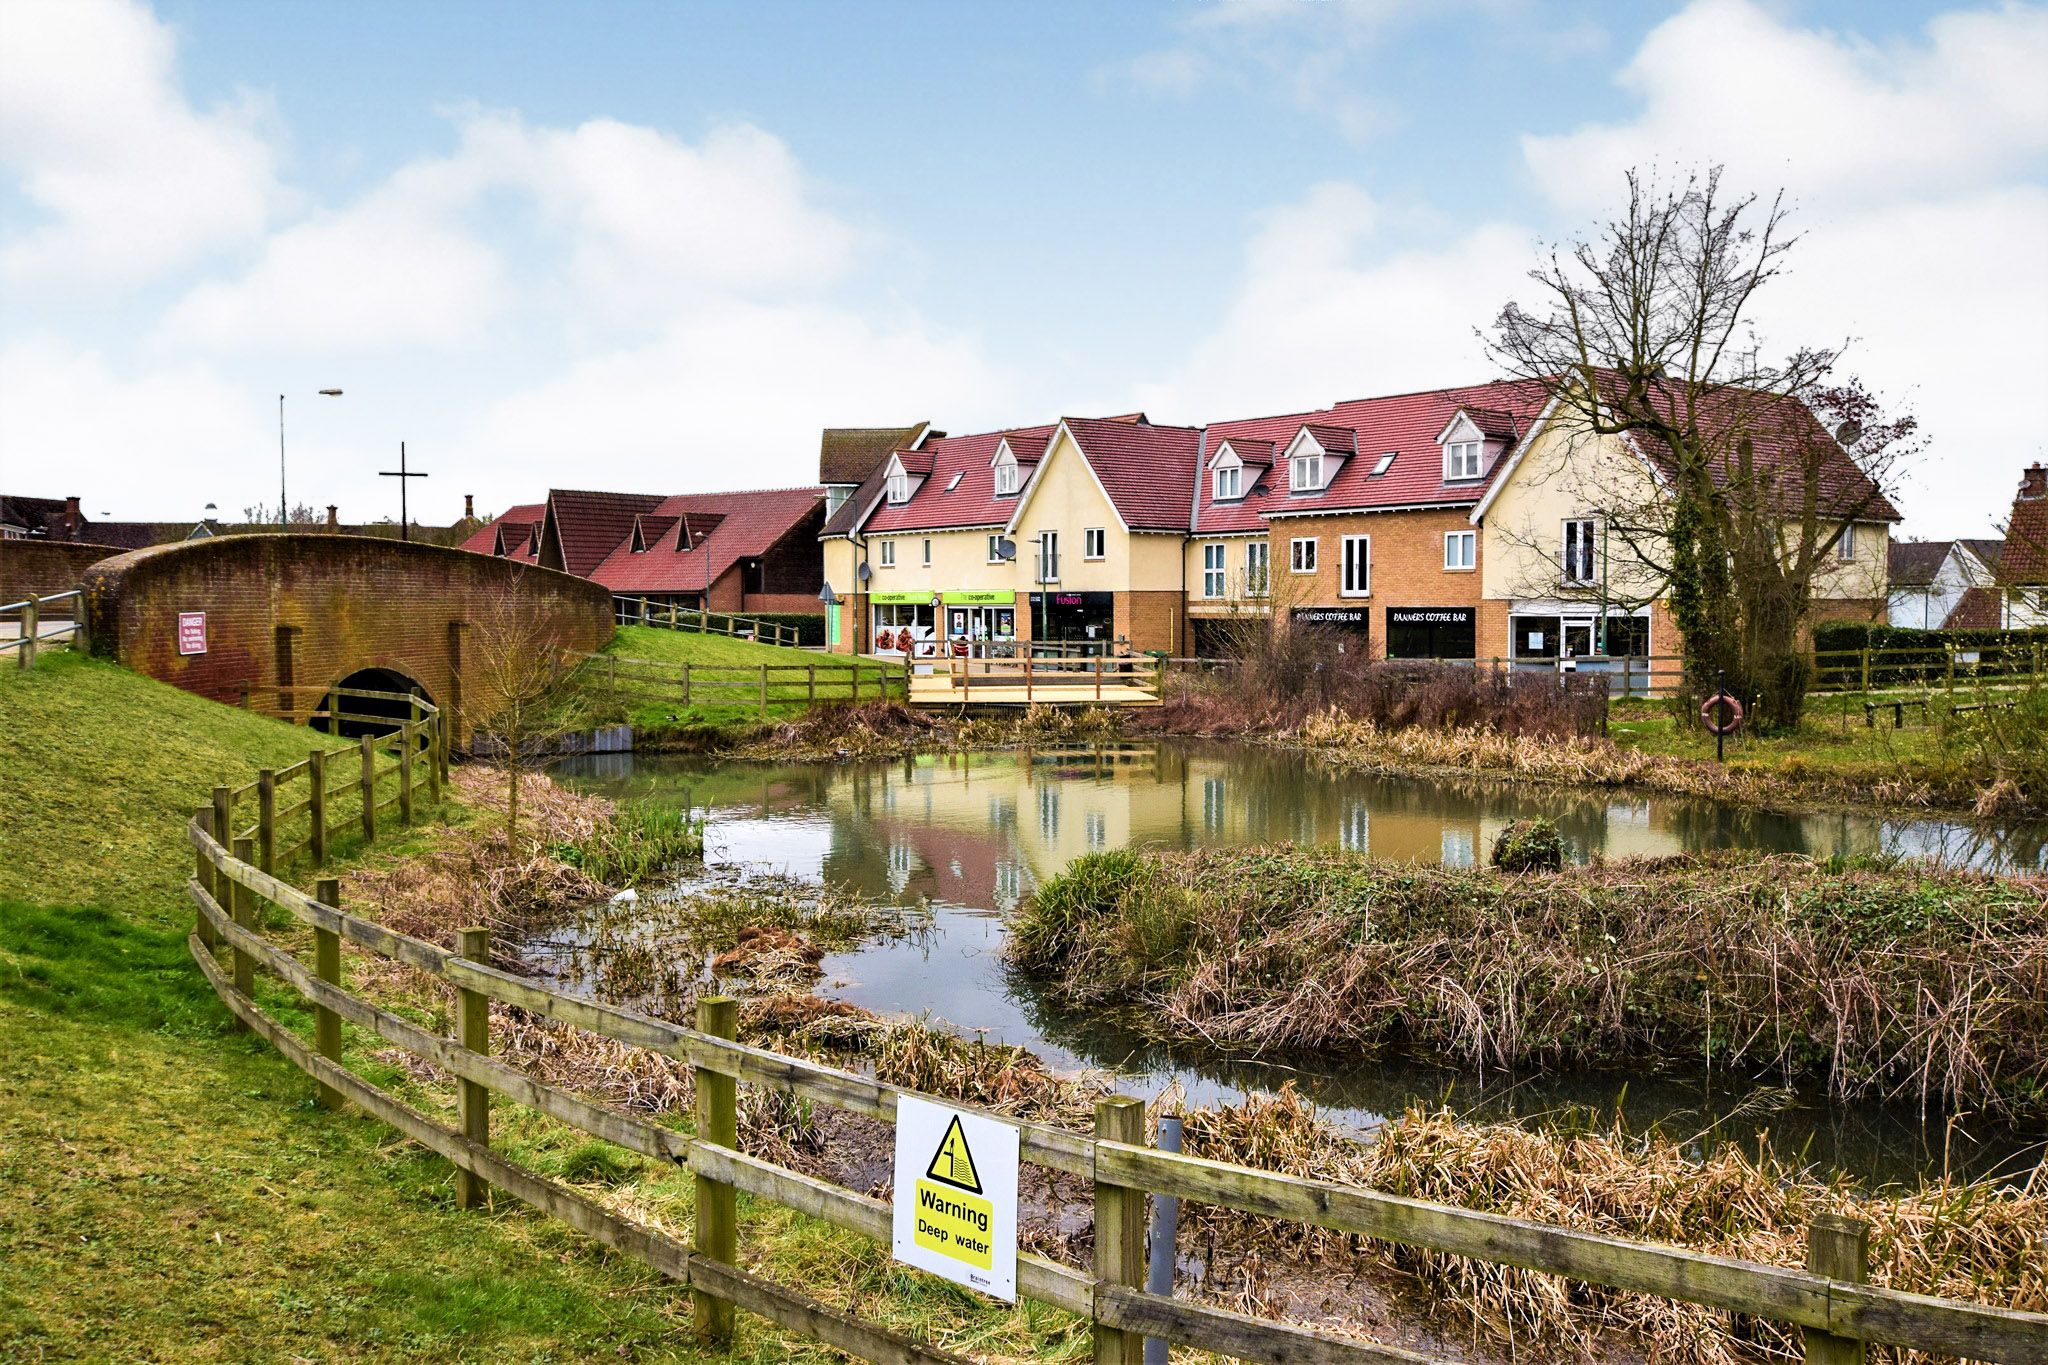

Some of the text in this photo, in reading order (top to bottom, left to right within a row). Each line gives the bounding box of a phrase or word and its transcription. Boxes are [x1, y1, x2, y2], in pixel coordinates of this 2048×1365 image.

[882, 594, 905, 602] co-operative
[968, 593, 995, 602] co-operative
[1325, 612, 1348, 621] COFFEE
[1349, 612, 1362, 621] BAR
[1425, 612, 1451, 622] COFFEE
[1452, 612, 1467, 622] BAR
[182, 617, 203, 627] DANGER
[920, 1188, 988, 1232] Warning
[918, 1218, 990, 1255] Deep water
